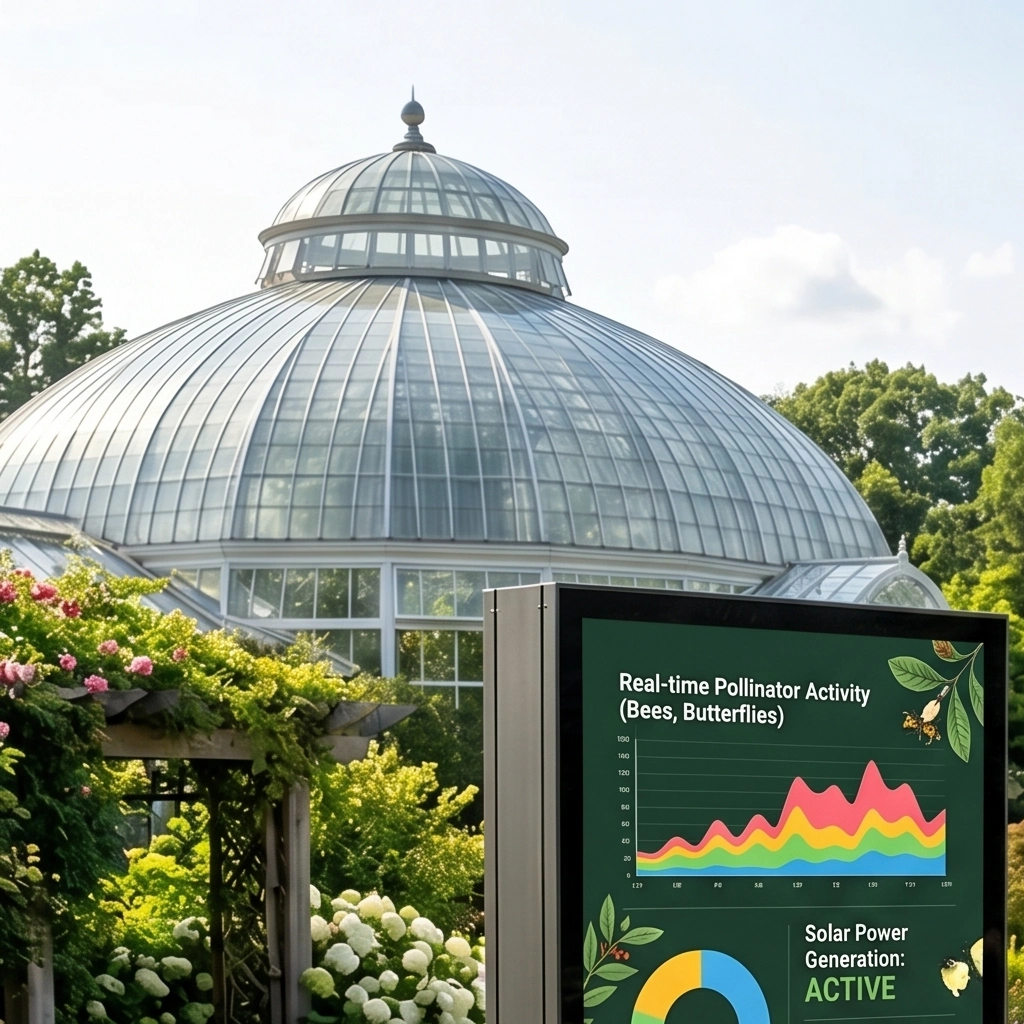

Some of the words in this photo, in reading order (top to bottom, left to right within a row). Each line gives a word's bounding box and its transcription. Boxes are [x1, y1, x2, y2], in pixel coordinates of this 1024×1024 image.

[620, 673, 709, 695] Real-time
[715, 678, 800, 699] Pollinator
[805, 682, 870, 707] Activity
[620, 699, 677, 723] (Bees,
[684, 703, 784, 729] Butterflies)
[805, 923, 850, 942] Solar
[856, 924, 908, 941] Power
[806, 949, 904, 968] Generation:
[805, 976, 895, 1002] ACTIVE
